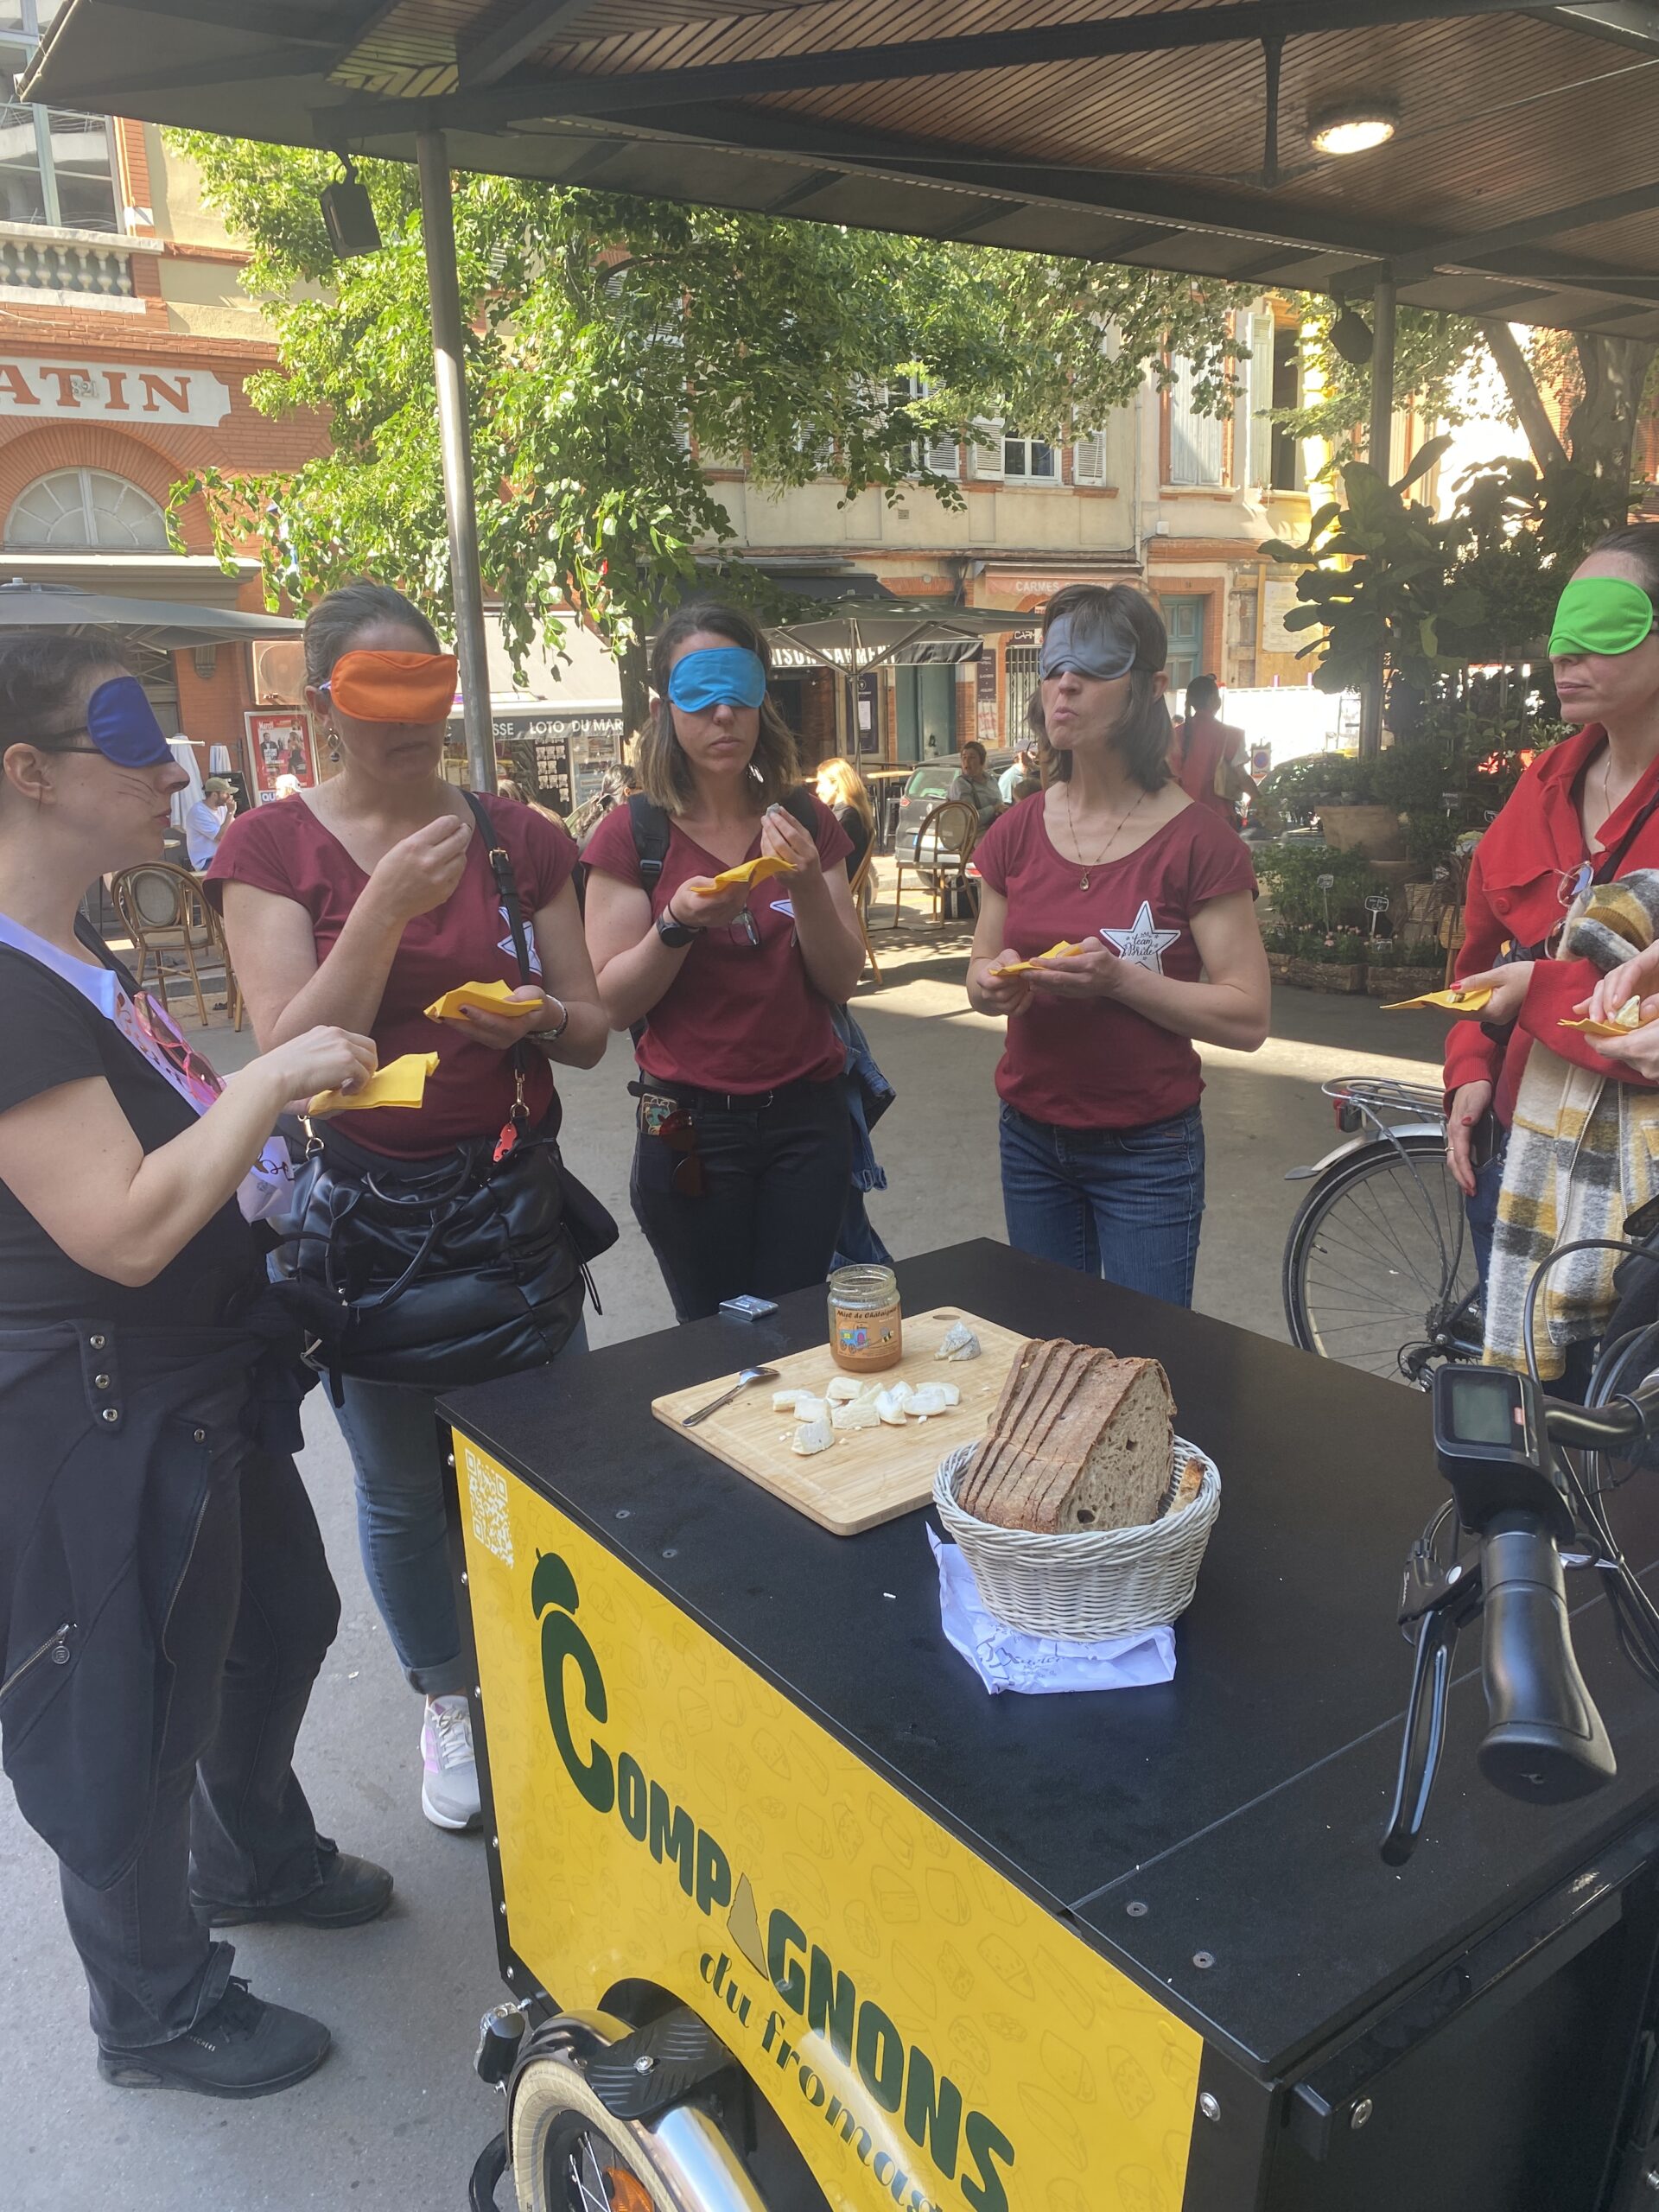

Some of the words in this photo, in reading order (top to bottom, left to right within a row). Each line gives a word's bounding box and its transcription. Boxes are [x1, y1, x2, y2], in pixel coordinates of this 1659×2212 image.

[1015, 581, 1059, 593] CARMES
[529, 721, 565, 734] LOTO
[571, 720, 590, 733] DU
[593, 718, 624, 732] MAR
[700, 1951, 752, 2029] du
